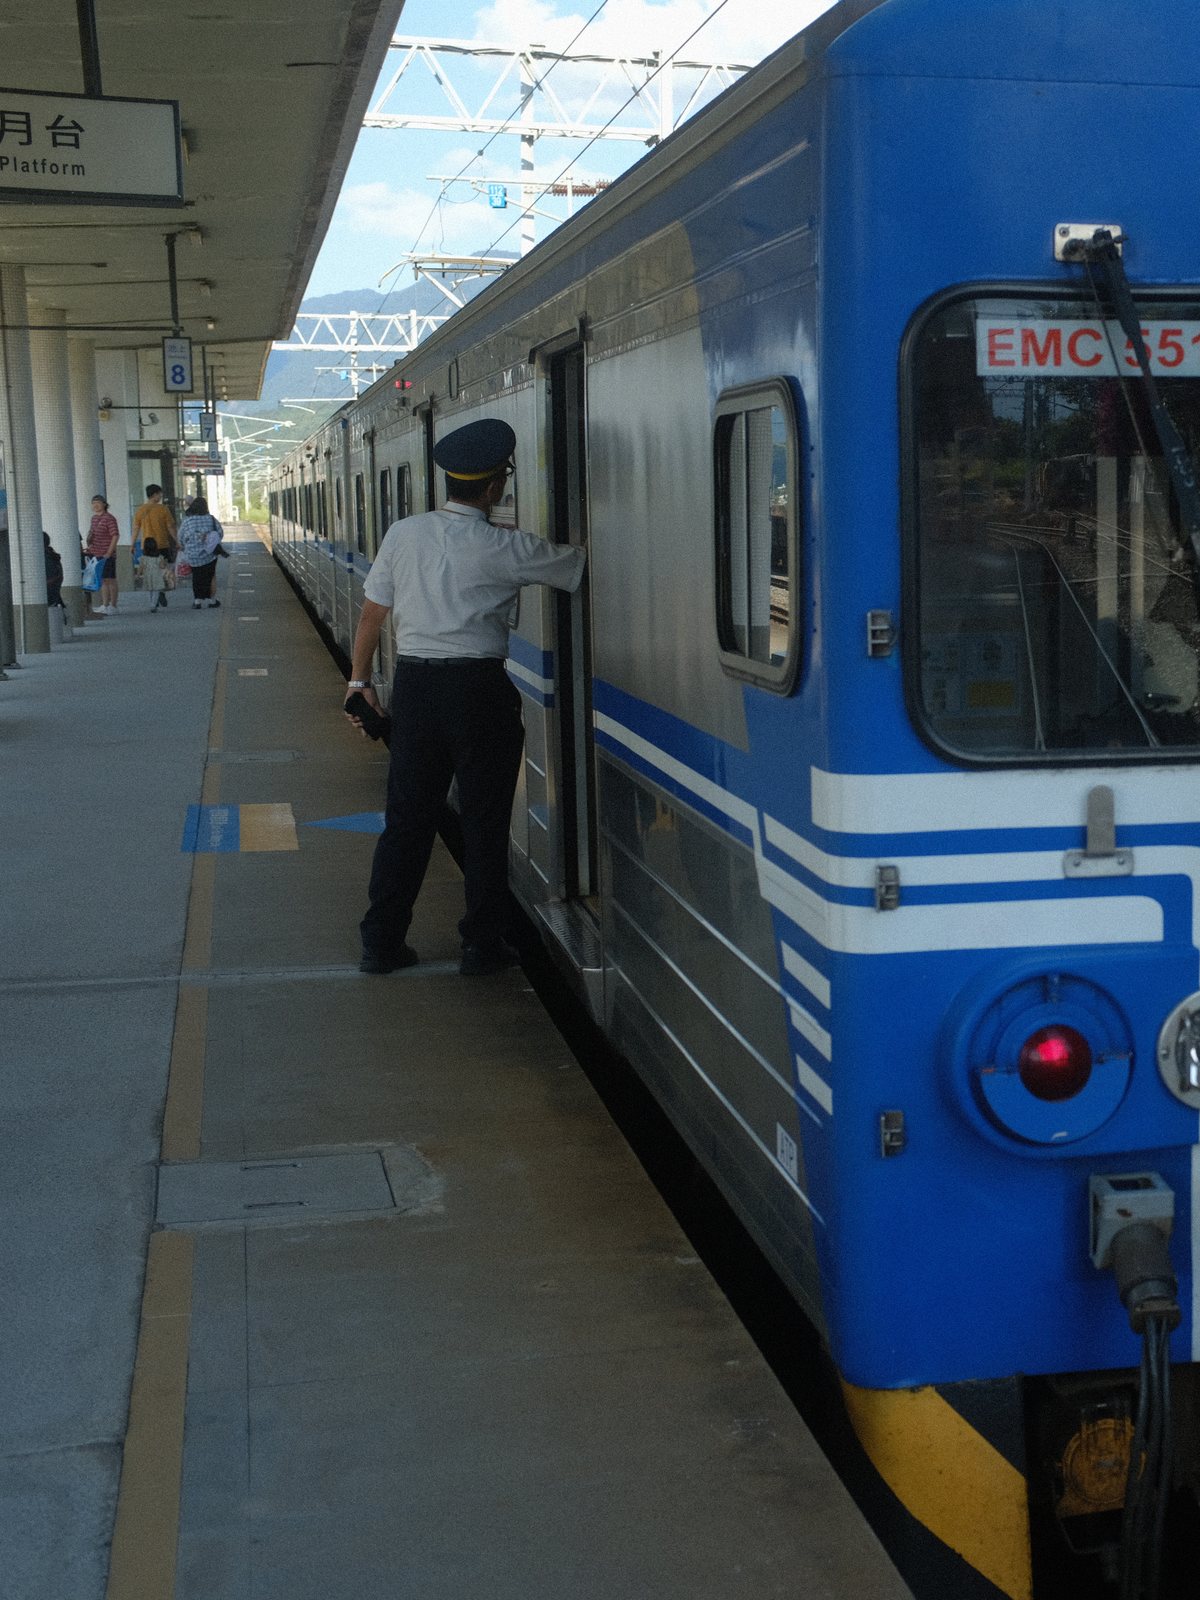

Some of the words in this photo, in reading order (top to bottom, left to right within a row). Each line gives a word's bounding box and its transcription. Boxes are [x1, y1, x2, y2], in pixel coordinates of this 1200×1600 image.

[0, 110, 85, 149] 月台
[0, 155, 86, 176] Platform
[987, 328, 1104, 367] EMC
[171, 364, 185, 385] 8
[204, 427, 212, 438] 7
